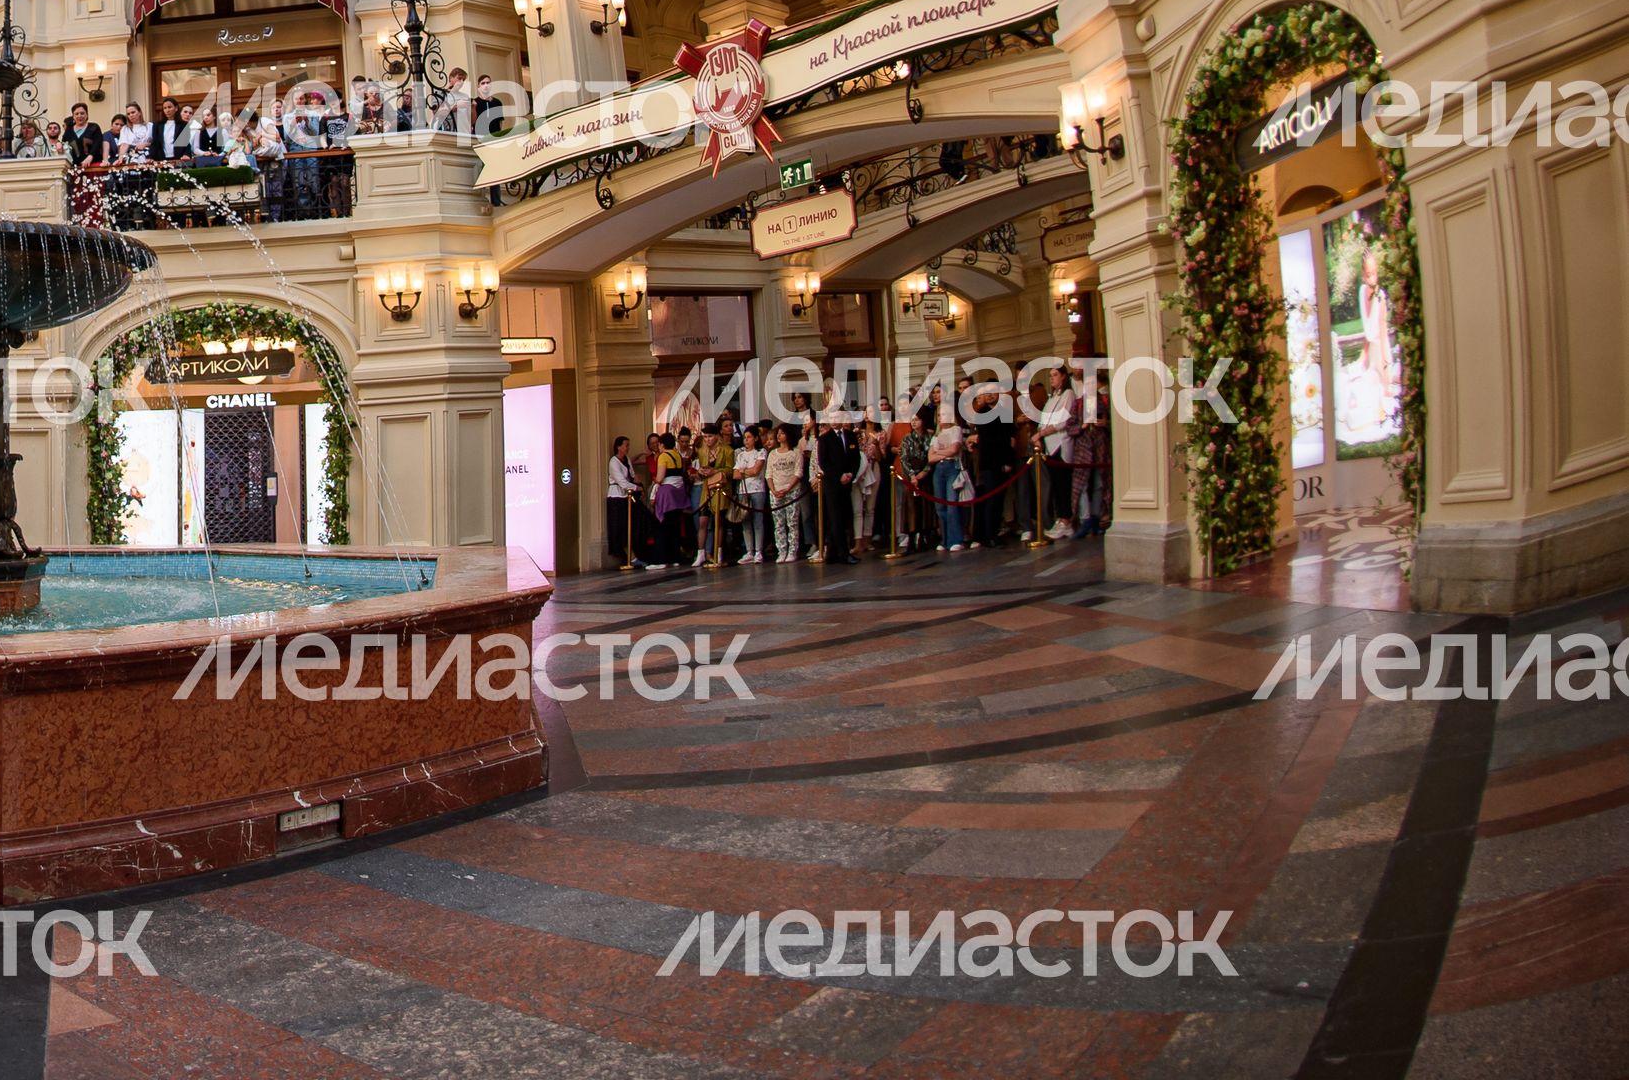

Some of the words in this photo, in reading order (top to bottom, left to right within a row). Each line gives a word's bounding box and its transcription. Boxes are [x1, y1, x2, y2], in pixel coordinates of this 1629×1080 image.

[809, 52, 829, 70] на
[832, 13, 903, 60] Красной
[708, 46, 739, 77] ГУМ
[730, 98, 758, 129] ПЛОЩАДЬ
[1258, 96, 1334, 155] ARTICOLI
[521, 125, 566, 160] Главный
[573, 110, 643, 137] магазин
[723, 131, 746, 149] GUM
[767, 223, 782, 235] НА
[798, 208, 838, 228] ЛИНИЮ
[1053, 238, 1064, 248] НА
[167, 356, 269, 377] АРТИКОЛИ
[205, 392, 277, 409] CHANEL
